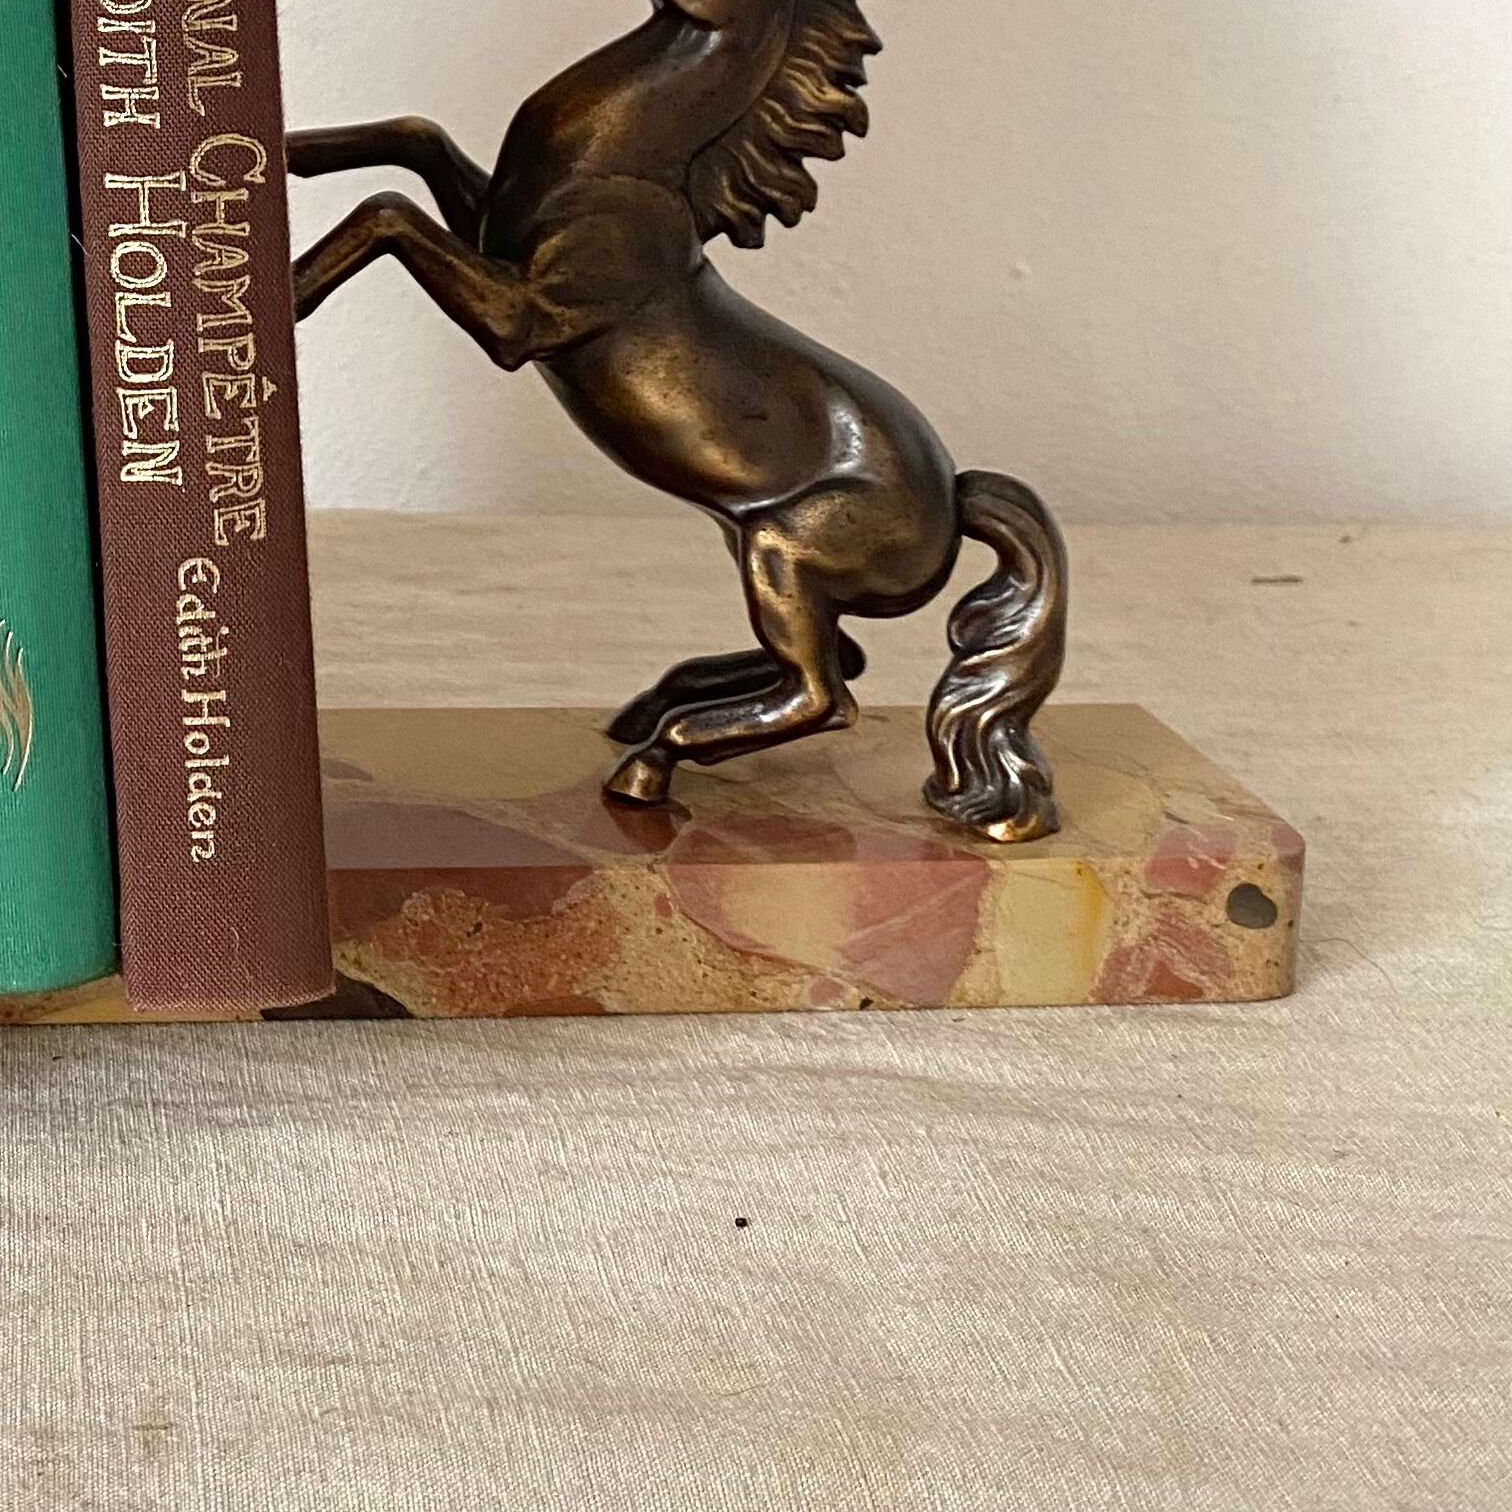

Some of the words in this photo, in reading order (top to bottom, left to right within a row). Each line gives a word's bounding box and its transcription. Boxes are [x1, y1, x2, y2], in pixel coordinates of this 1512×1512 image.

[103, 171, 188, 486] HOLDEN
[176, 557, 229, 680] Edith
[181, 689, 231, 863] Holden
